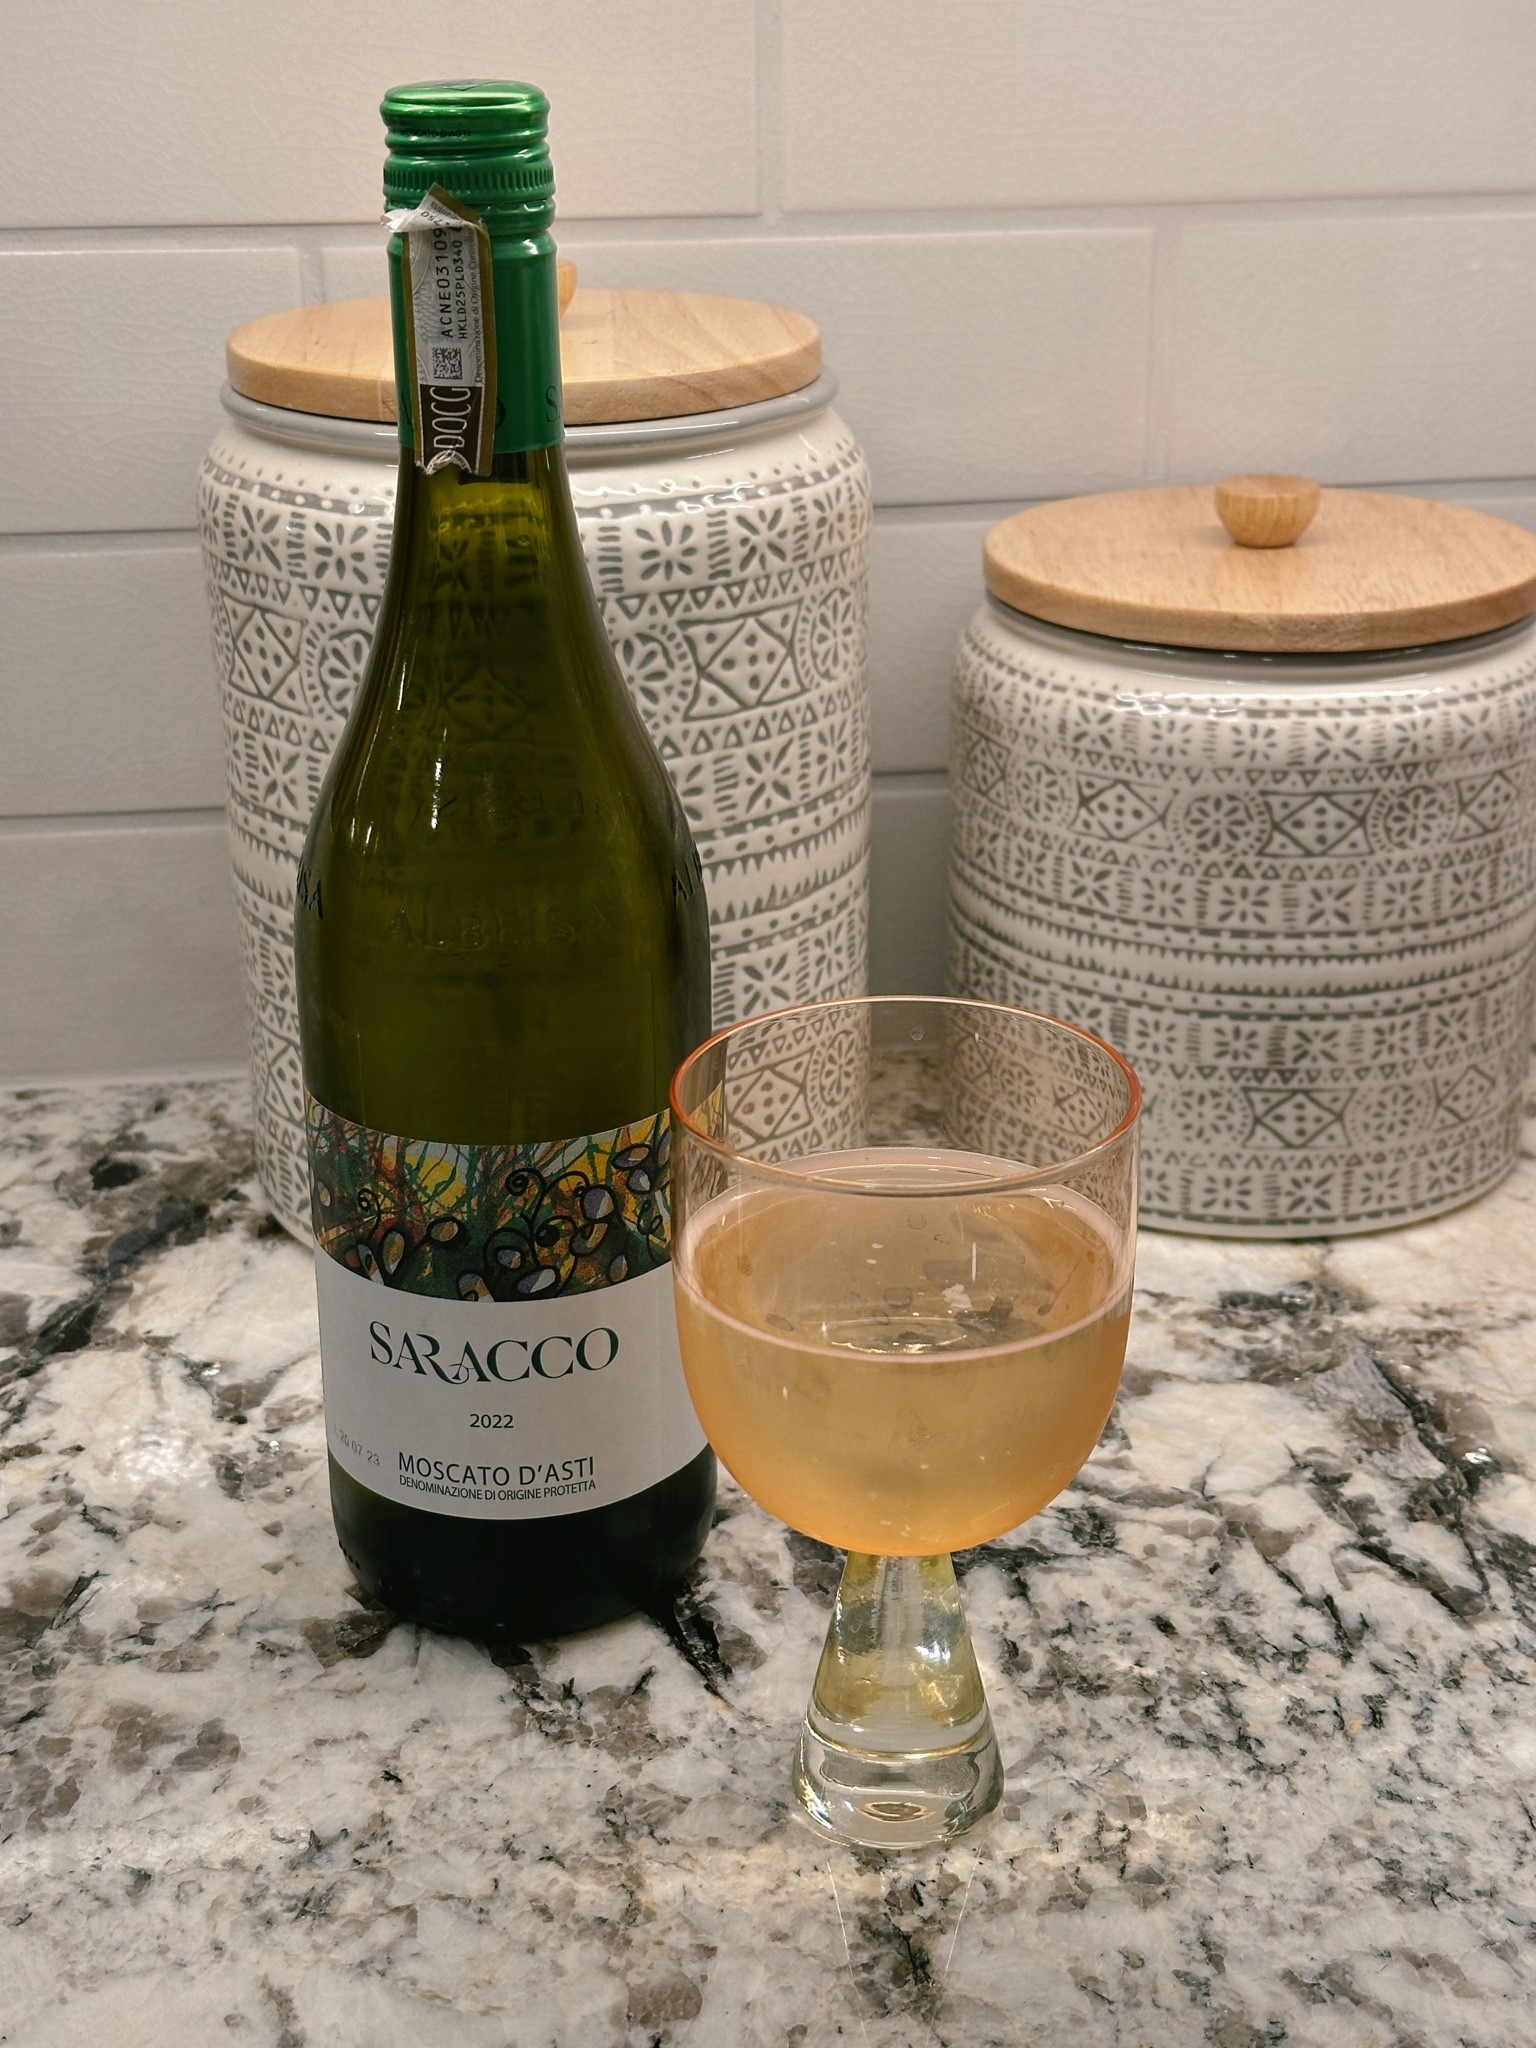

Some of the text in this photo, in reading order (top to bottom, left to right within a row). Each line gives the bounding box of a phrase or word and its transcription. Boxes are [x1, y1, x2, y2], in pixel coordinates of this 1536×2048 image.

[430, 386, 471, 449] DOCG
[369, 1320, 619, 1385] SARACCO
[469, 1413, 514, 1429] 2022
[352, 1440, 363, 1455] 07
[366, 1450, 381, 1466] 23
[399, 1451, 594, 1487] MOSCATO D'ASTI
[399, 1474, 597, 1501] DENOMINAZIONE DI ORIGINE PROTETTA
